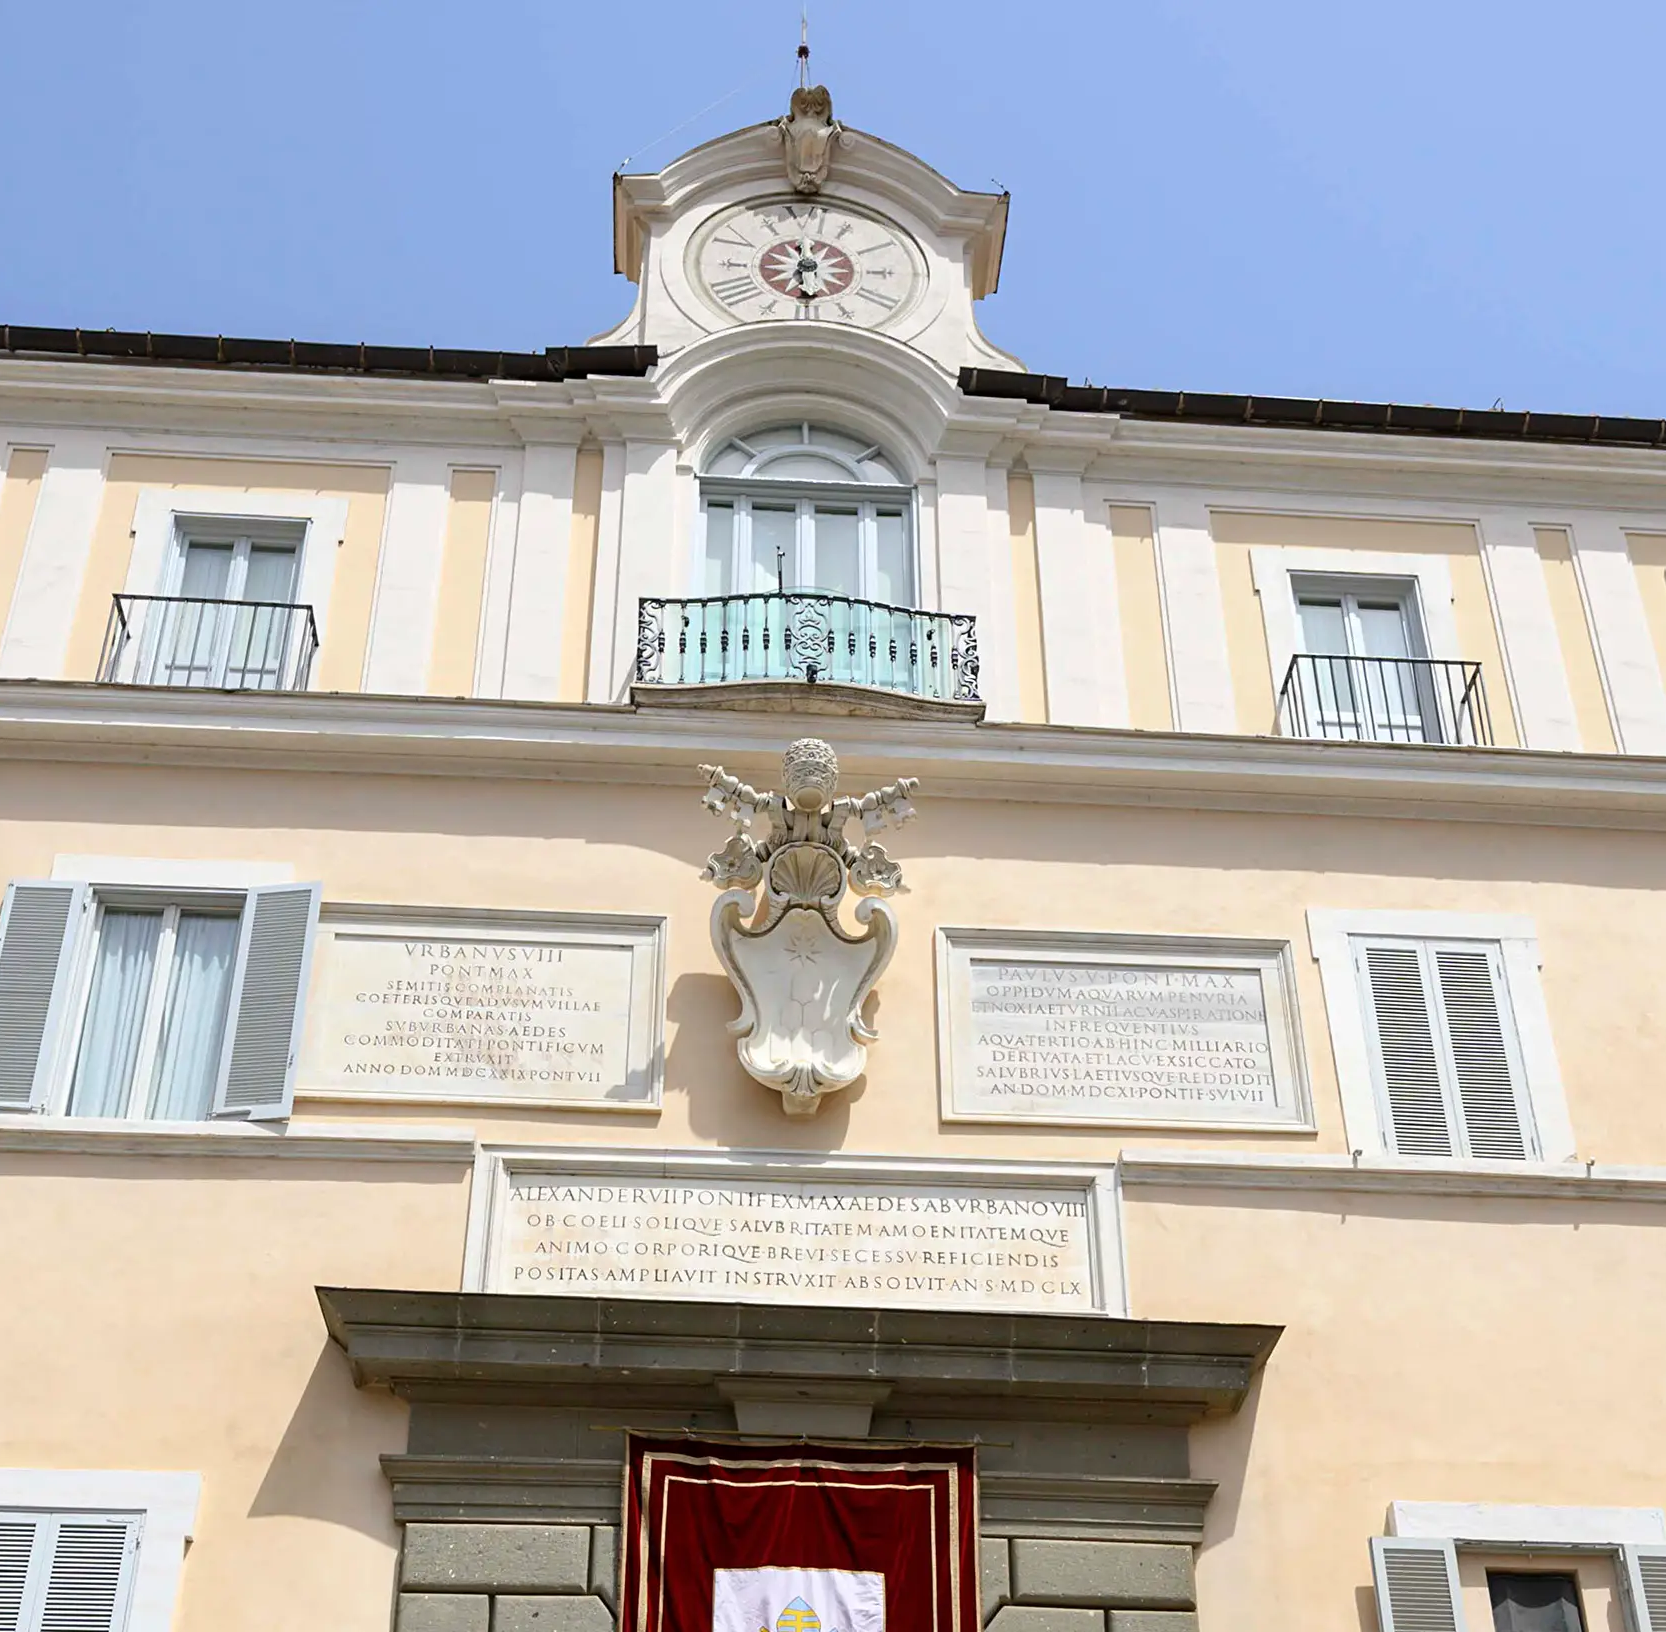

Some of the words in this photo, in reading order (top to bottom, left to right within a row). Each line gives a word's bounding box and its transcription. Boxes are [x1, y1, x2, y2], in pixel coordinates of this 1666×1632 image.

[404, 943, 517, 961] VRBANVS
[521, 948, 563, 963] VIII
[430, 964, 486, 977] PONT
[488, 967, 534, 980] MAX
[998, 967, 1078, 983] PAVLVS
[1107, 971, 1172, 986] PONT
[1182, 974, 1235, 989] MAX
[386, 980, 450, 992] SEMITIS
[454, 981, 574, 997] COMPLANATIS
[986, 985, 1072, 999] OPPIDVM
[1075, 988, 1163, 1004] AQVARVM
[1168, 991, 1248, 1006] PENVRIA
[422, 1008, 532, 1022] COMPARATIS
[547, 1000, 601, 1012] VILLAE
[385, 1020, 504, 1036] SVBVRBANAS
[508, 1026, 567, 1038] AEDES
[1045, 1019, 1200, 1037] INFREQVENTIVS
[344, 1034, 482, 1049] COMMODITATI
[486, 1039, 604, 1055] PONTIFICVM
[1172, 1039, 1269, 1054] MILLIARIO
[433, 1052, 514, 1065] EXTRVXIT
[992, 1050, 1083, 1065] DERIVATA
[1156, 1055, 1256, 1070] EXSICCATO
[343, 1063, 395, 1075] ANNO
[400, 1065, 441, 1077] DOM
[976, 1065, 1070, 1081] SALVBRIVS
[1179, 1072, 1273, 1086] REDDIDIT
[510, 1186, 648, 1204] ALEXANDER
[648, 1188, 677, 1205] VII
[683, 1189, 795, 1210] PONTIFEX
[796, 1194, 845, 1211] MAX
[847, 1196, 920, 1212] AEDES
[923, 1198, 951, 1213] AB
[953, 1199, 1049, 1217] VRBANO
[1050, 1202, 1085, 1218] VIII
[527, 1213, 555, 1228] OB
[562, 1214, 627, 1229] COELI
[633, 1216, 723, 1237] SOLIQVE
[730, 1218, 873, 1237] SALVBRITATEM
[878, 1223, 1069, 1248] AMOENITATEMQVE
[534, 1241, 608, 1255] ANIMO
[615, 1241, 761, 1264] CORPORIQVE
[767, 1246, 825, 1262] BREVI
[830, 1248, 918, 1263] SECESSV
[922, 1250, 1060, 1268] REFICIENDIS
[514, 1266, 600, 1281] POSITAS
[604, 1267, 718, 1283] AMPLIAVIT
[725, 1271, 837, 1288] INSTRVXIT
[844, 1275, 946, 1291] ABSOLVIT
[949, 1278, 978, 1292] AN
